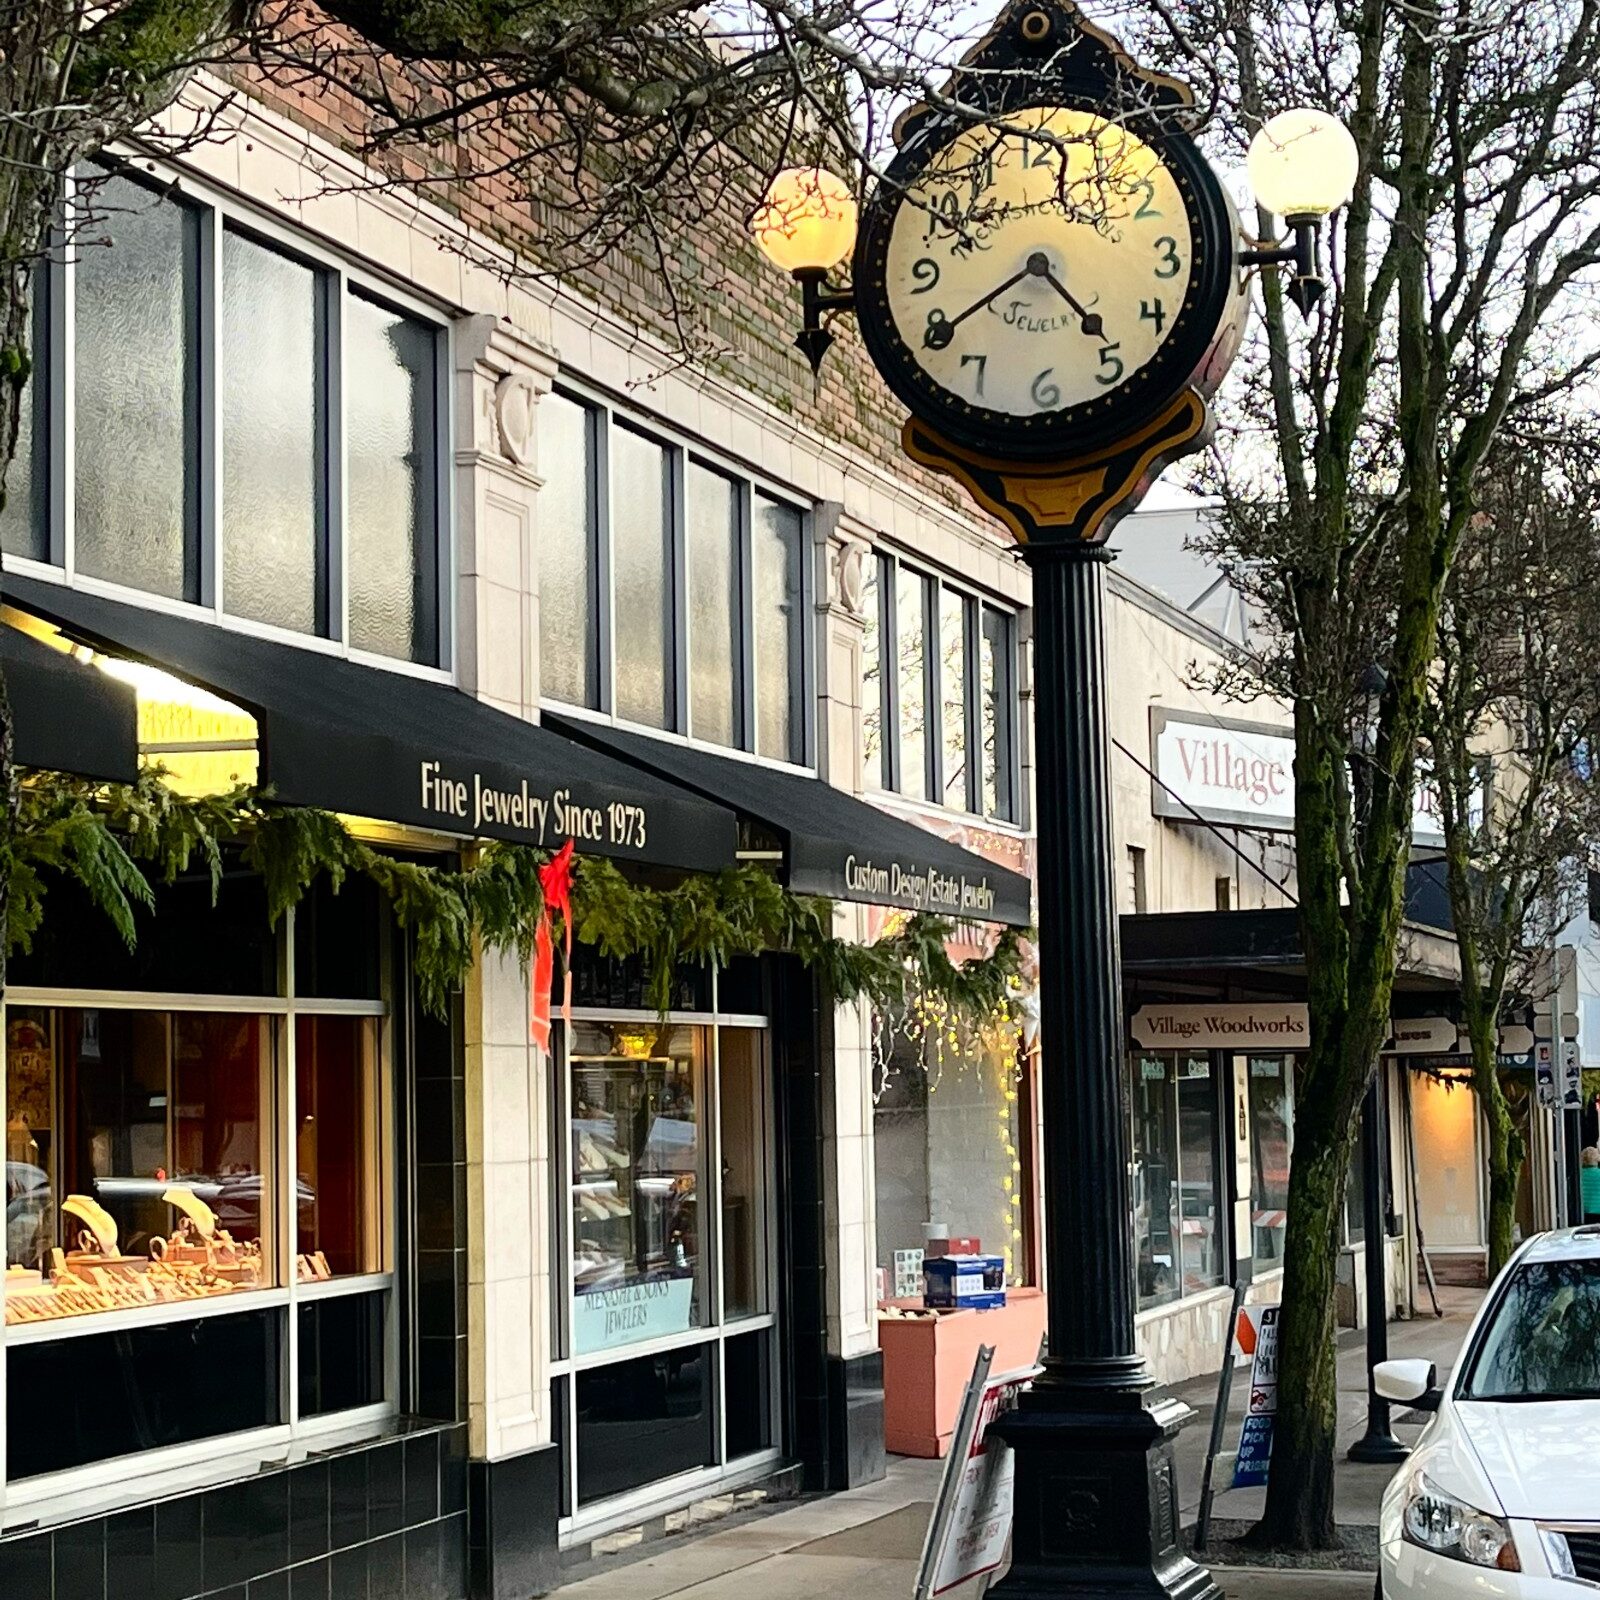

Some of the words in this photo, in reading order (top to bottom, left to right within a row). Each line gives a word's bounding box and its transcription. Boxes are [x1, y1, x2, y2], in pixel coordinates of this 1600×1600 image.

[1130, 181, 1163, 220] 2
[910, 258, 940, 294] 9
[1153, 236, 1181, 279] 3
[1140, 296, 1167, 336] 4
[960, 354, 987, 397] 7
[1095, 342, 1124, 385] 5
[1031, 368, 1060, 408] 6
[1175, 736, 1286, 806] Village
[421, 761, 468, 817] Fine
[473, 773, 549, 846] Jewelry
[553, 788, 602, 841] Since
[607, 801, 645, 849] 1973
[845, 854, 889, 894] Custom
[960, 875, 996, 916] Jewelry
[1147, 1016, 1200, 1039] Village
[1203, 1015, 1304, 1034] Woodworks
[605, 1303, 648, 1339] JEWELERS
[1240, 1446, 1255, 1458] UP
